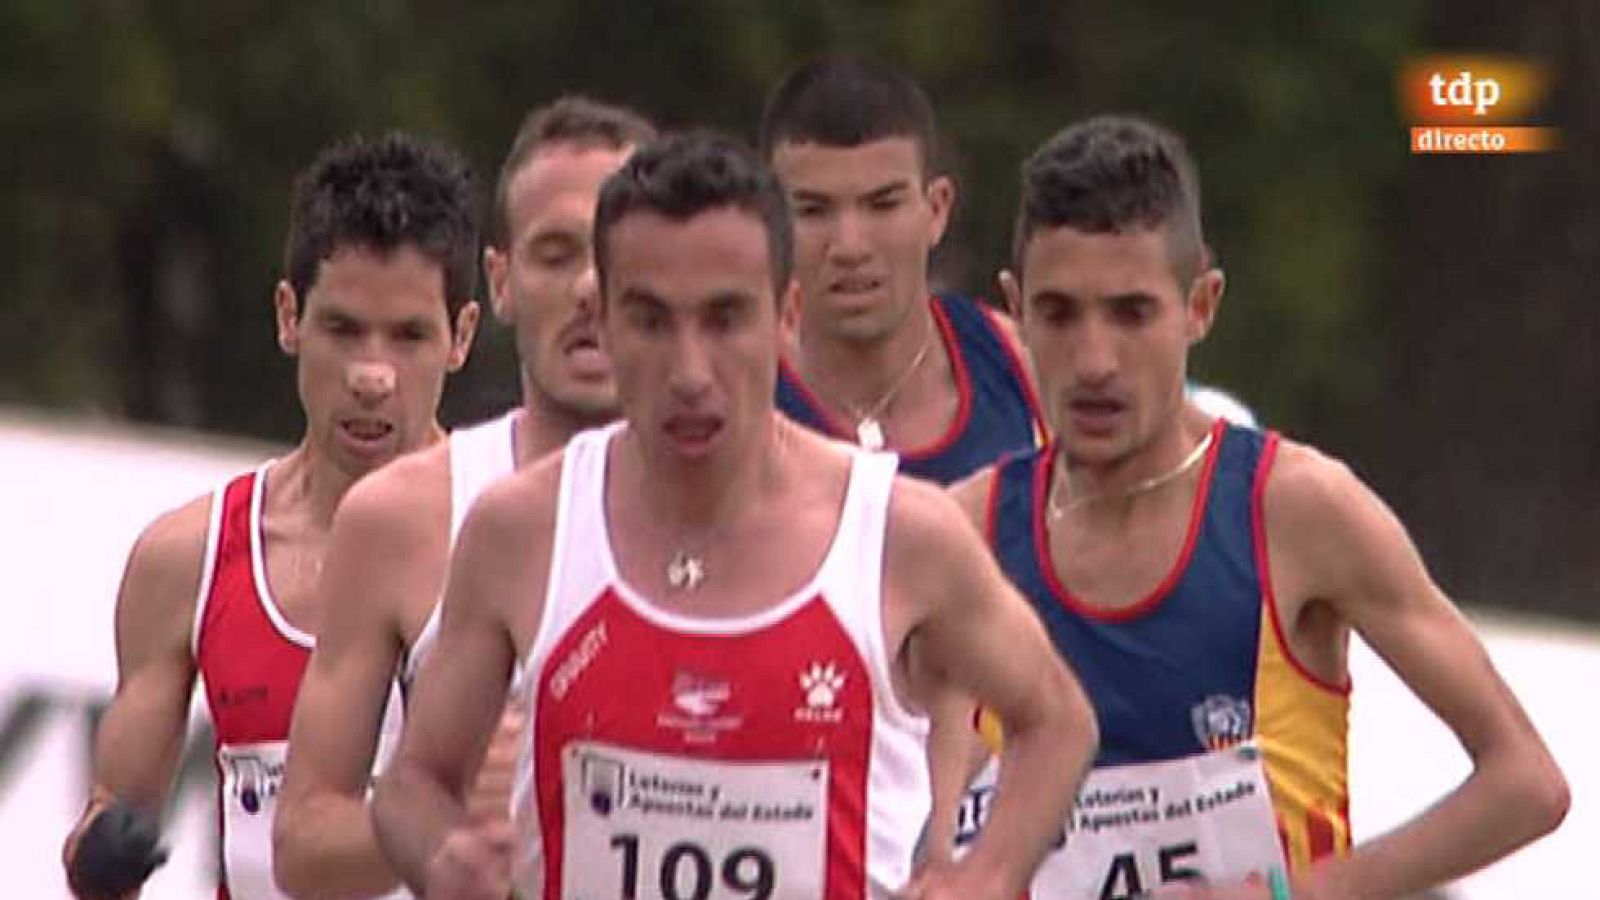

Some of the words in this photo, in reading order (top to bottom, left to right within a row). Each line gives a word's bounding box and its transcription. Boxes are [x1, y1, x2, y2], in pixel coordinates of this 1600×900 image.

[719, 800, 748, 820] del
[752, 802, 814, 822] Estado
[1165, 798, 1192, 819] del
[1196, 780, 1255, 814] Estado
[610, 833, 775, 900] 109
